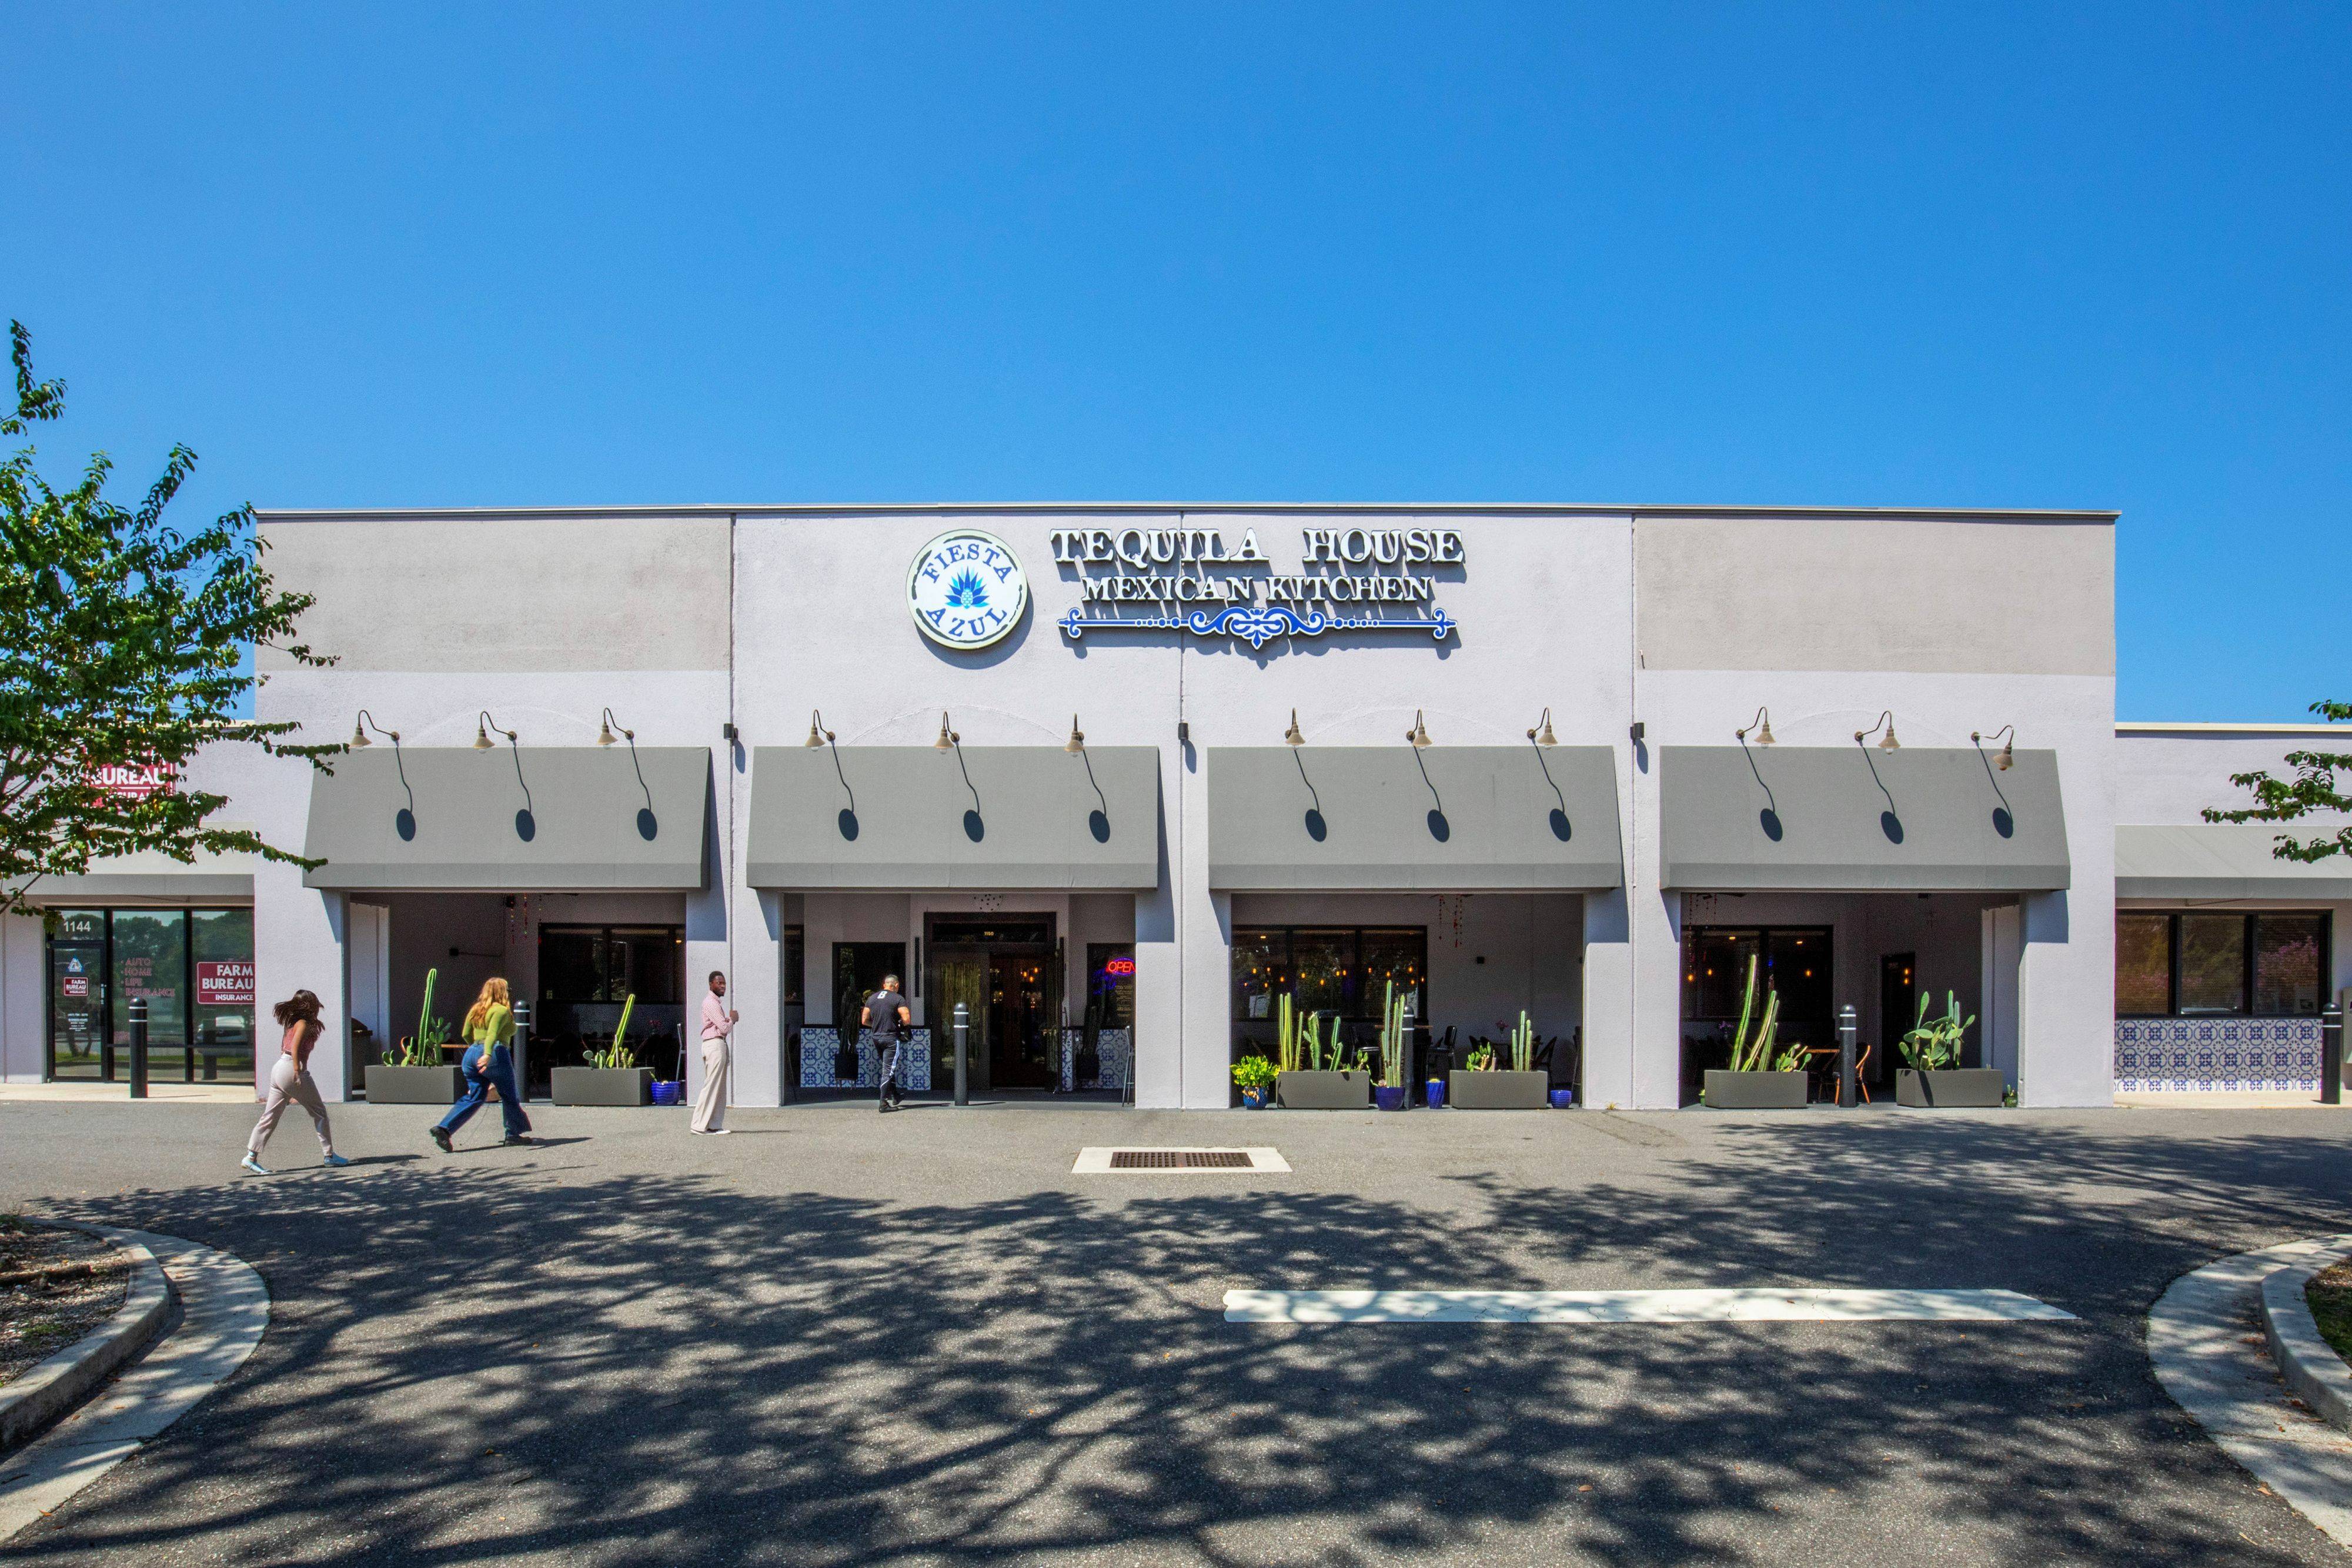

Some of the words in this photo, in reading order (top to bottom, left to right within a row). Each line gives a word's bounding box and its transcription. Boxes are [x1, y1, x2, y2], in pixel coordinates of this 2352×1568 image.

[1050, 527, 1270, 569] TEQUILA
[1302, 528, 1464, 564] HOUSE
[922, 543, 1012, 584] FIESTA
[1081, 576, 1254, 601] MEXICAN
[1265, 576, 1431, 602] KITCHEN
[926, 608, 1007, 637] AZUL
[64, 921, 92, 932] 1144
[125, 958, 151, 966] AUTO
[1108, 961, 1135, 972] OPEN
[125, 968, 152, 976] HOME
[217, 965, 253, 976] FARM
[202, 978, 254, 990] BUREAU
[125, 988, 176, 997] INSURANCE
